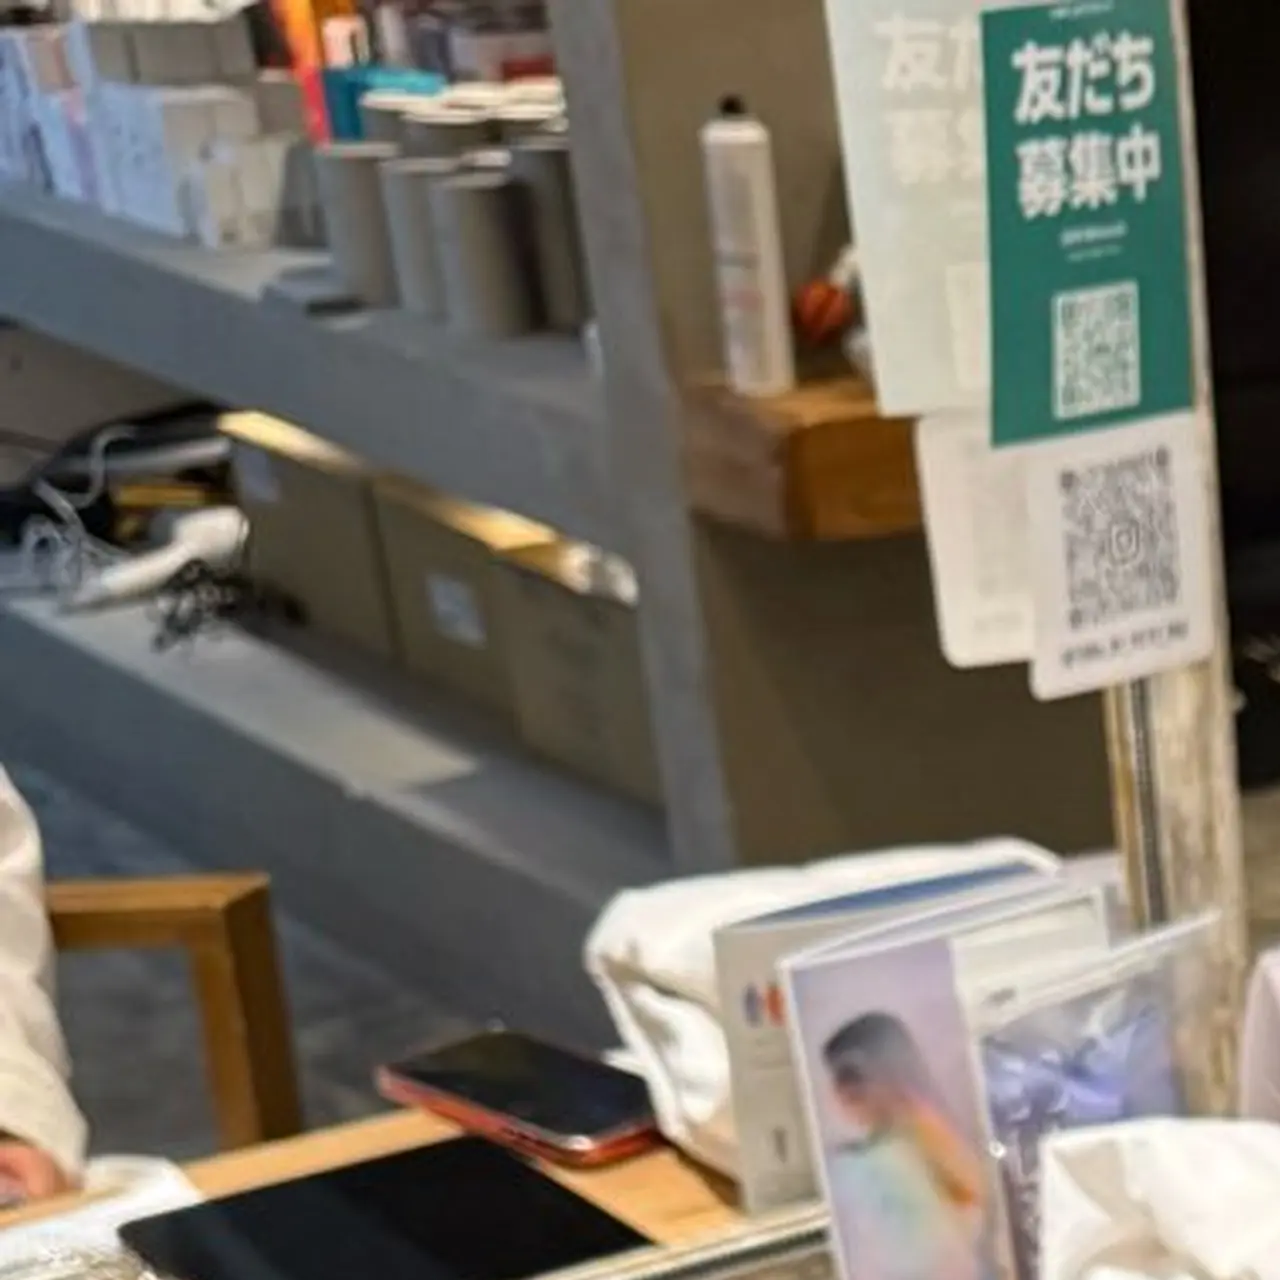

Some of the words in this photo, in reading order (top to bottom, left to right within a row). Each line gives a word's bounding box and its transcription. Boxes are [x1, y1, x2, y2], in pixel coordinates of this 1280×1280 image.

[1012, 32, 1154, 123] 友だち
[1015, 124, 1161, 219] 募集中
